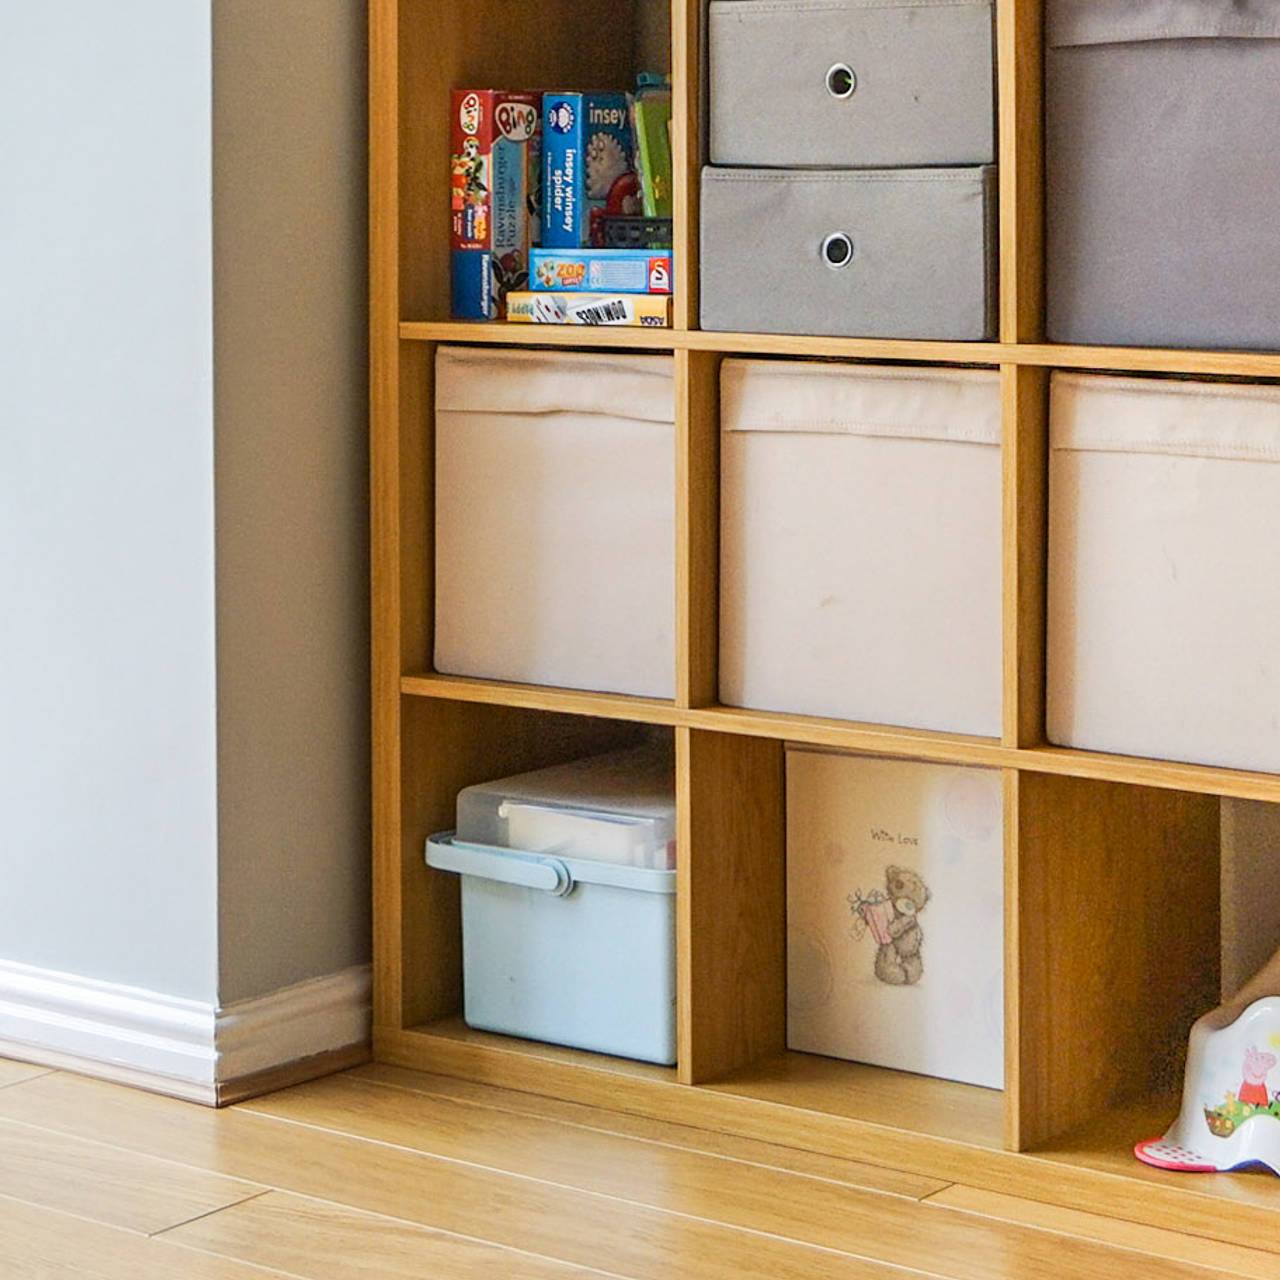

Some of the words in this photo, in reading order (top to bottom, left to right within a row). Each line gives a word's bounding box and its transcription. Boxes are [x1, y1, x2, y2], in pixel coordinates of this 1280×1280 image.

[463, 95, 478, 132] Bing
[497, 106, 535, 135] Bing
[589, 103, 626, 129] insey
[563, 148, 577, 184] insey
[495, 145, 507, 248] Ravensburger
[552, 170, 564, 211] spider
[506, 200, 516, 248] Puzzle
[561, 186, 576, 232] winsey
[480, 254, 490, 316] Ravensburger
[576, 300, 628, 325] DOMINOES
[639, 315, 665, 326] ASDA
[897, 834, 919, 846] Love
